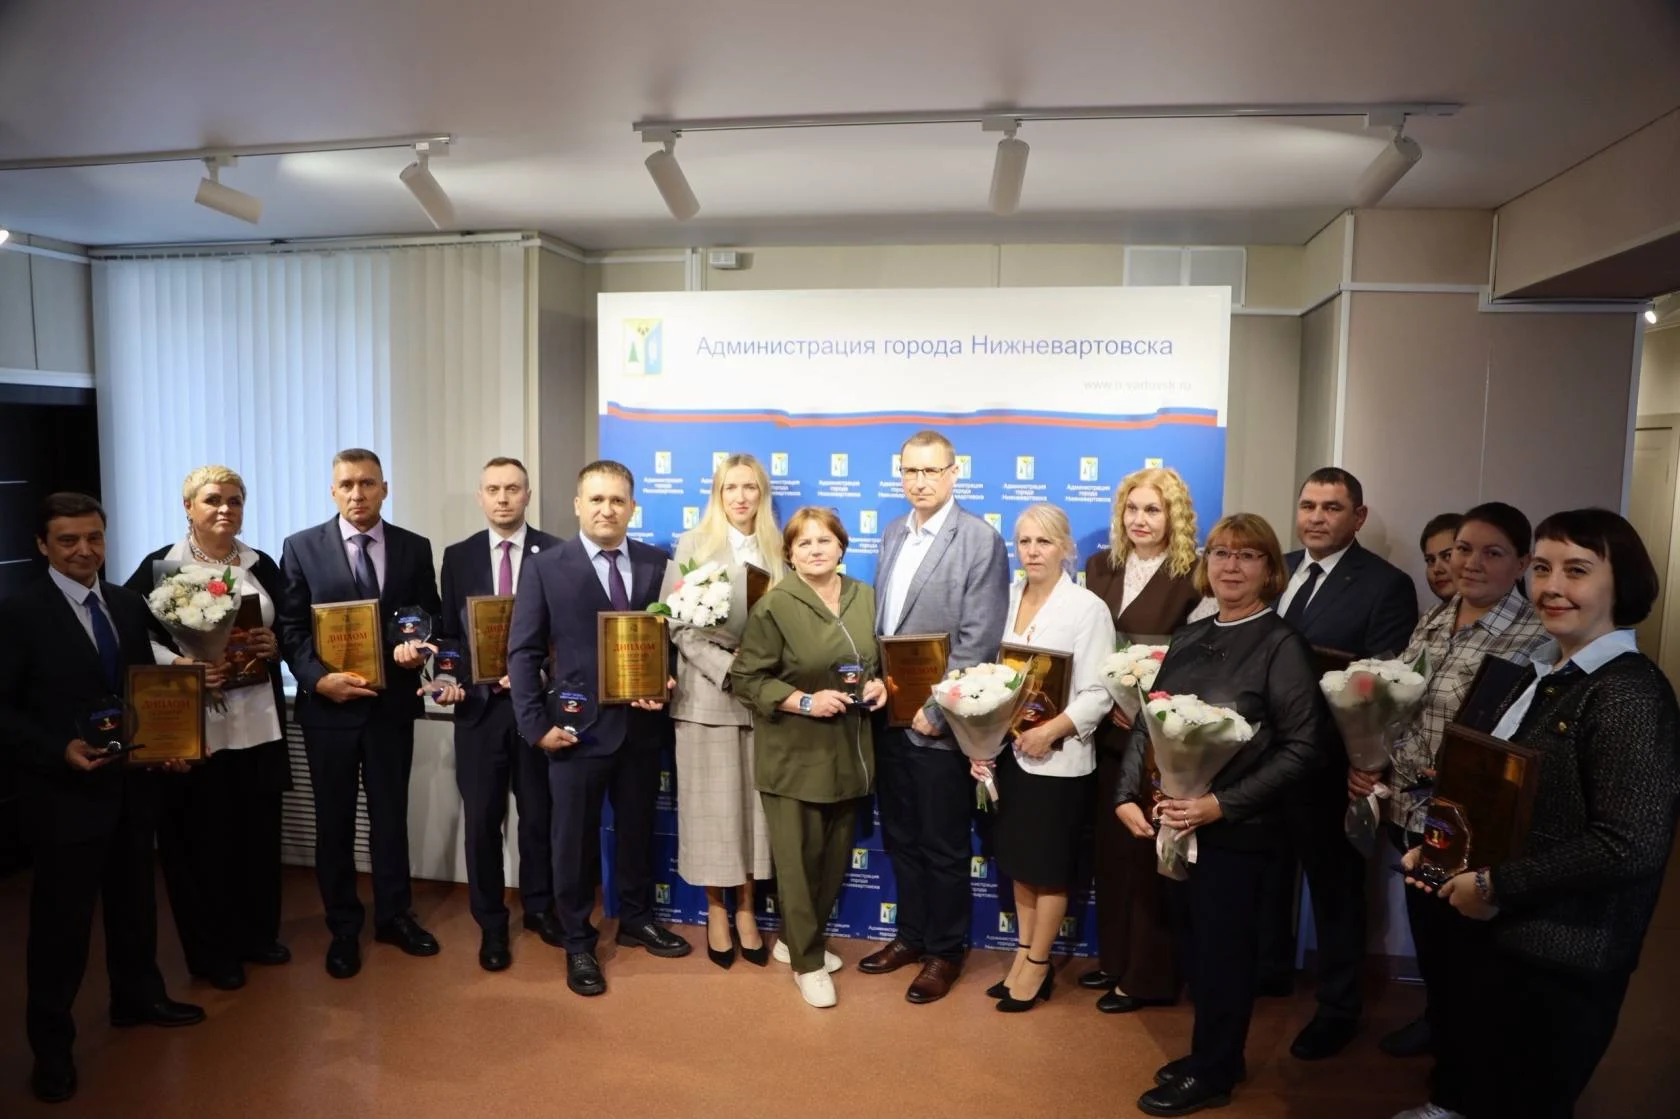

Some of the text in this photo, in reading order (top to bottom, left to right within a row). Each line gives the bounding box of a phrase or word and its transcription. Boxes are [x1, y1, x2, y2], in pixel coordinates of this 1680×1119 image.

[697, 335, 1173, 360] Администрация города Нижневартовска
[327, 631, 369, 644] ДИПЛОМ
[613, 642, 656, 652] ДИПЛОМ
